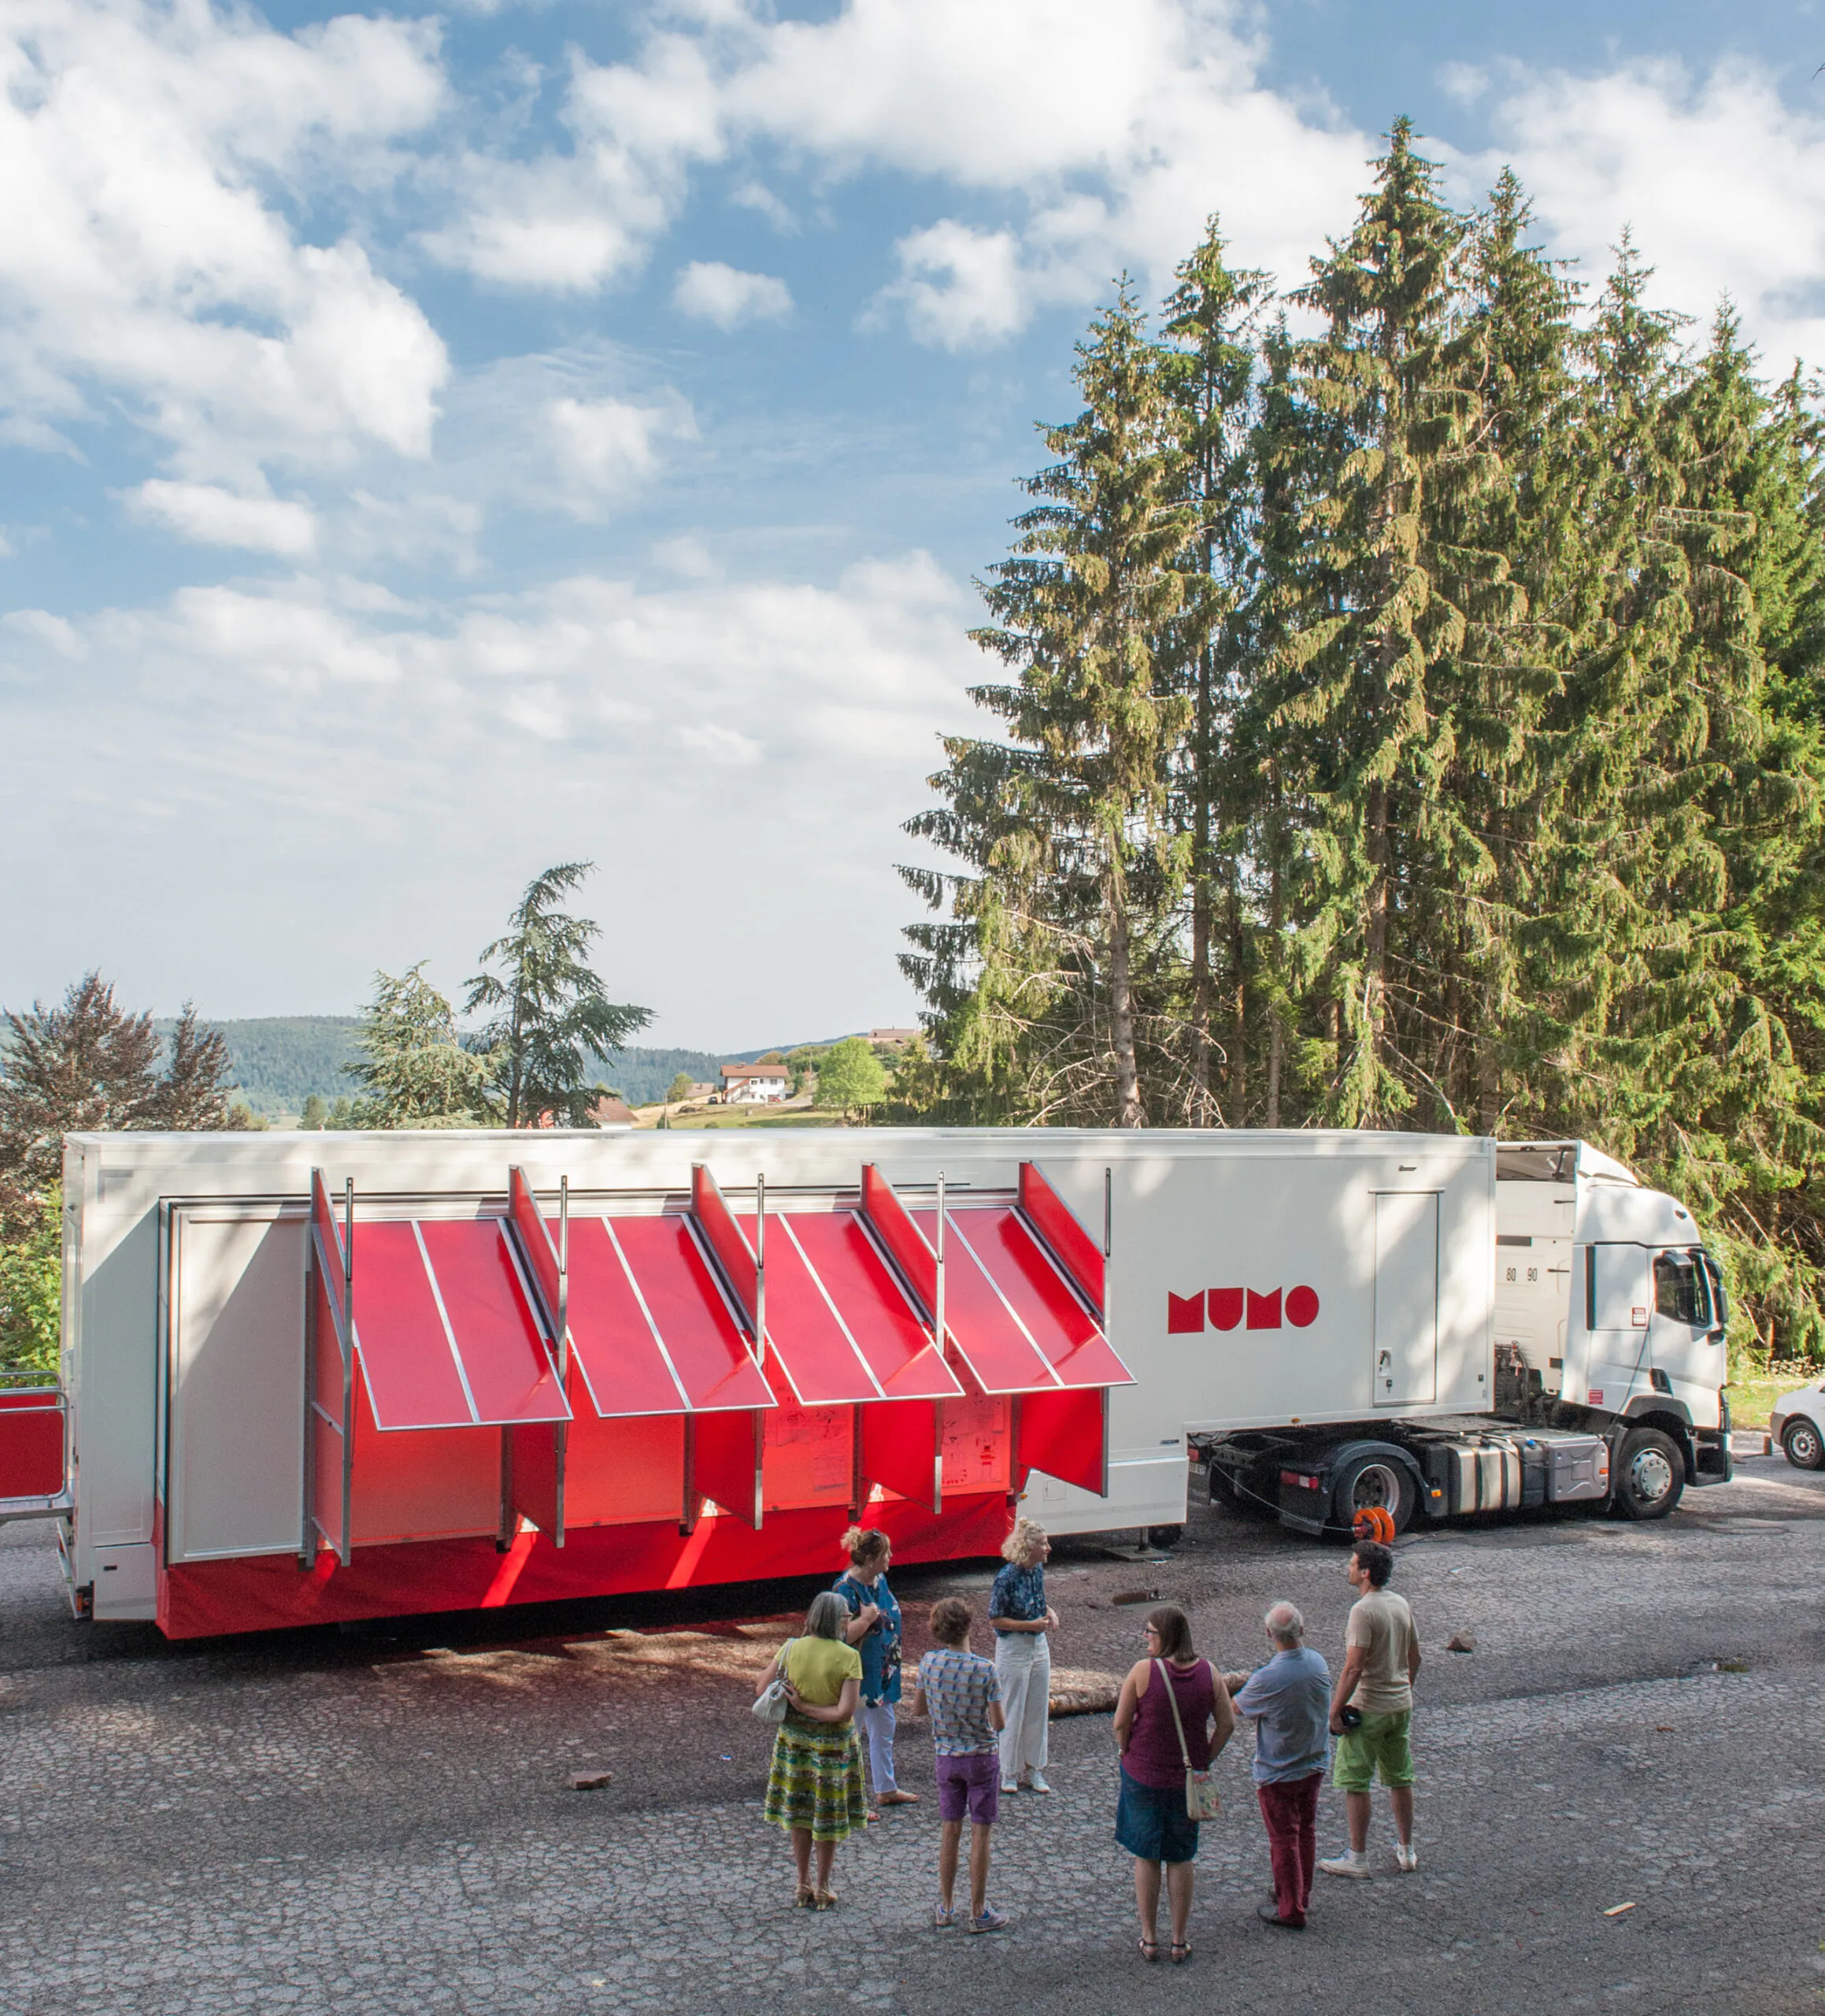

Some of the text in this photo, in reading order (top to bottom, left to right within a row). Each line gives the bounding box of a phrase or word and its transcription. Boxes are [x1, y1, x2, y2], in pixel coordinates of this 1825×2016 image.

[1506, 1267, 1538, 1281] 80 90
[1168, 1284, 1320, 1334] MUMO
